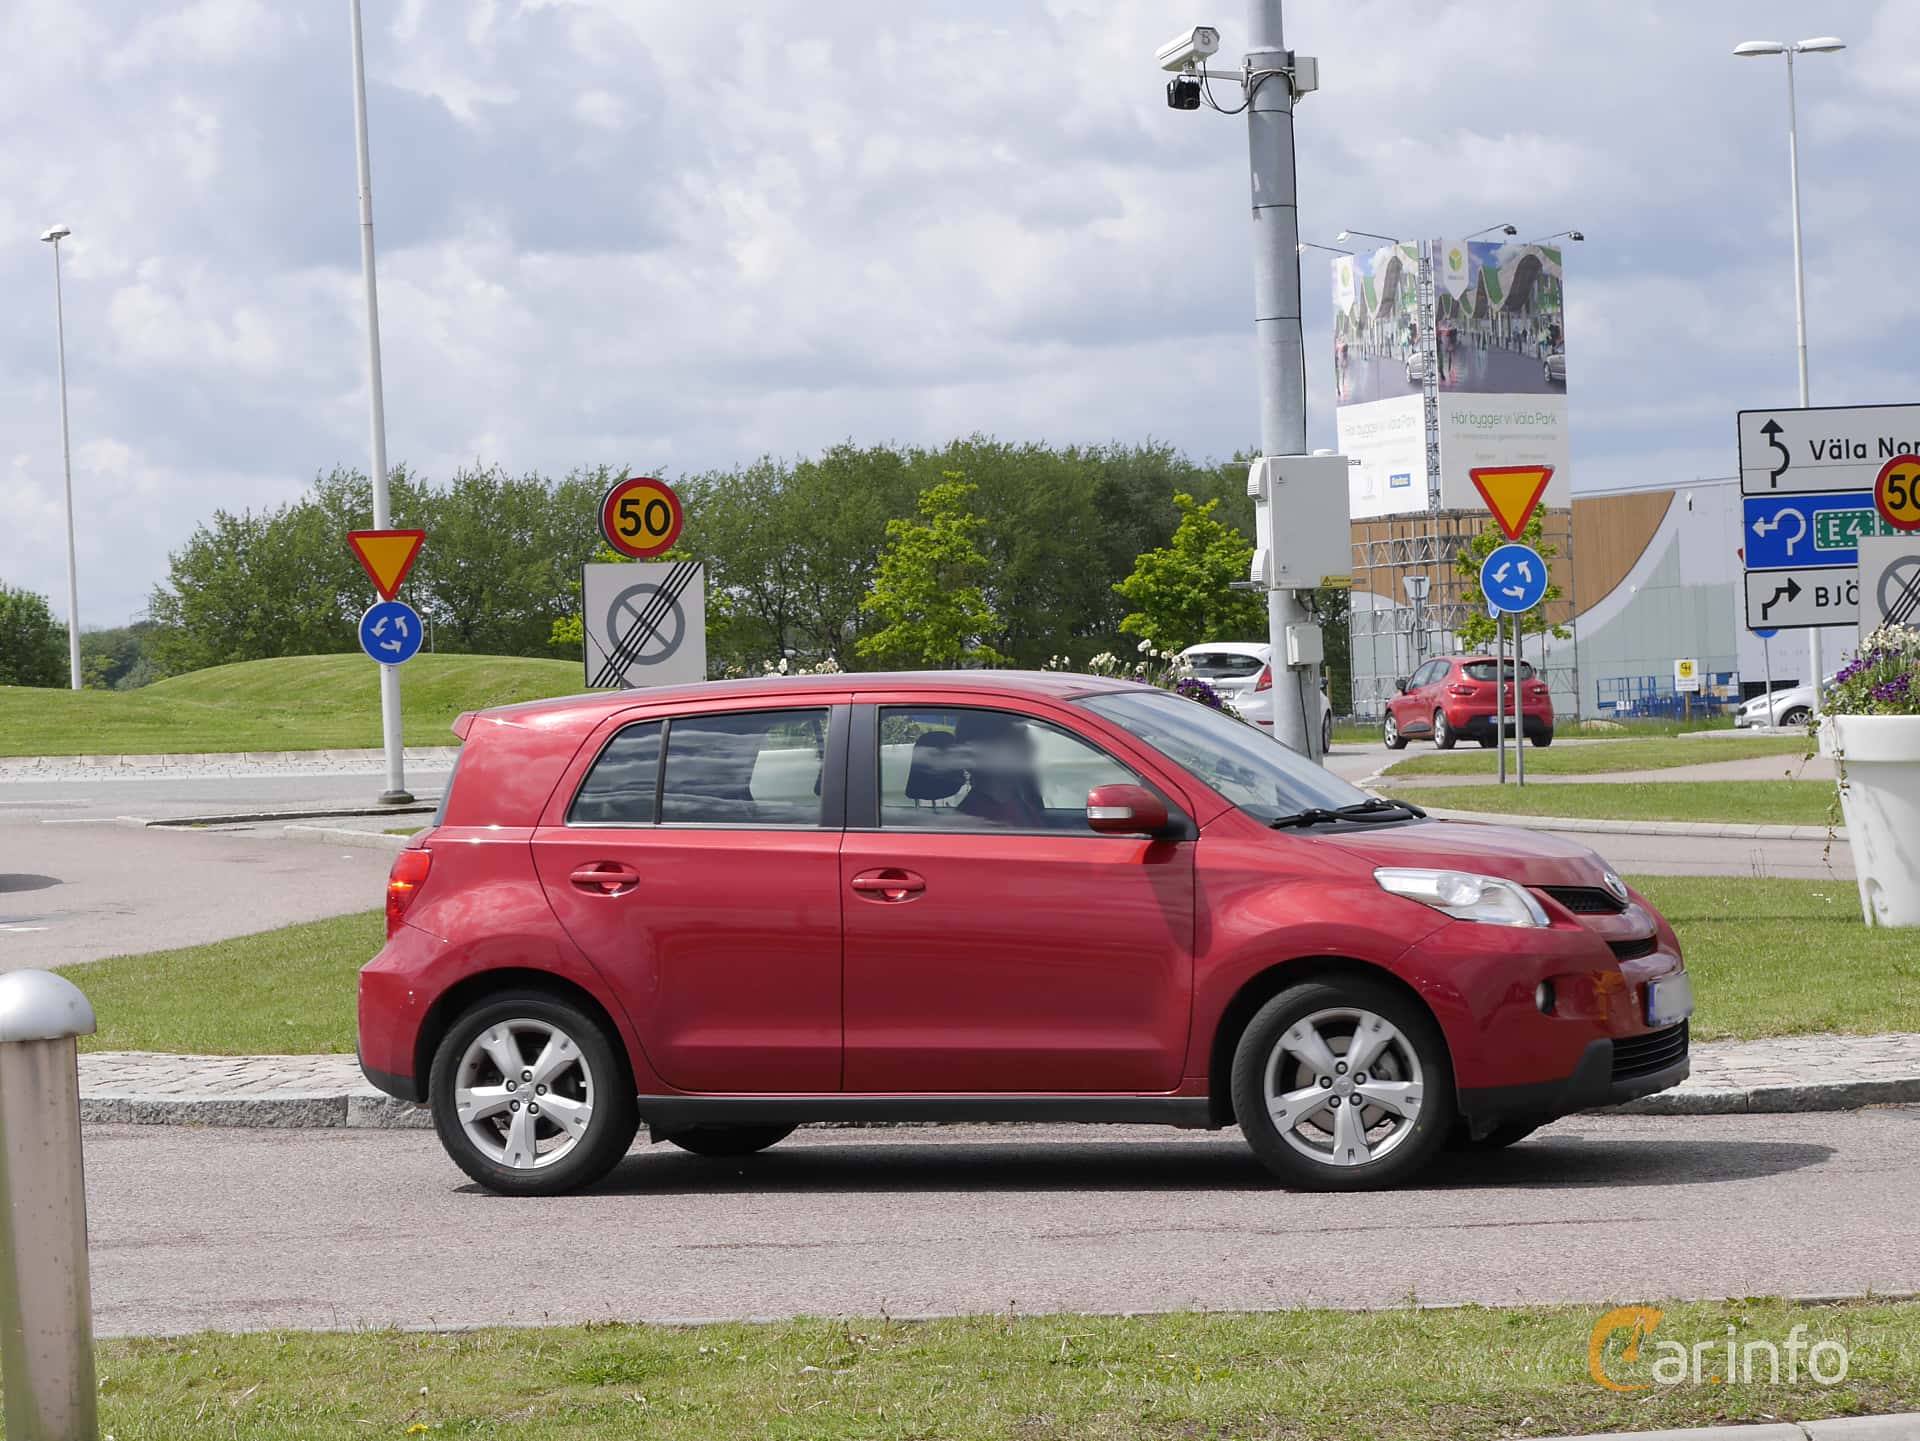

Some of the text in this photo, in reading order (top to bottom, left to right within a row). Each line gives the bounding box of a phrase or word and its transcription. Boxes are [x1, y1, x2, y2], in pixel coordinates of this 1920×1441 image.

[1536, 411, 1557, 424] Park
[1809, 438, 1866, 460] Väla
[619, 498, 671, 537] 50
[1815, 579, 1859, 607] BJÖ
